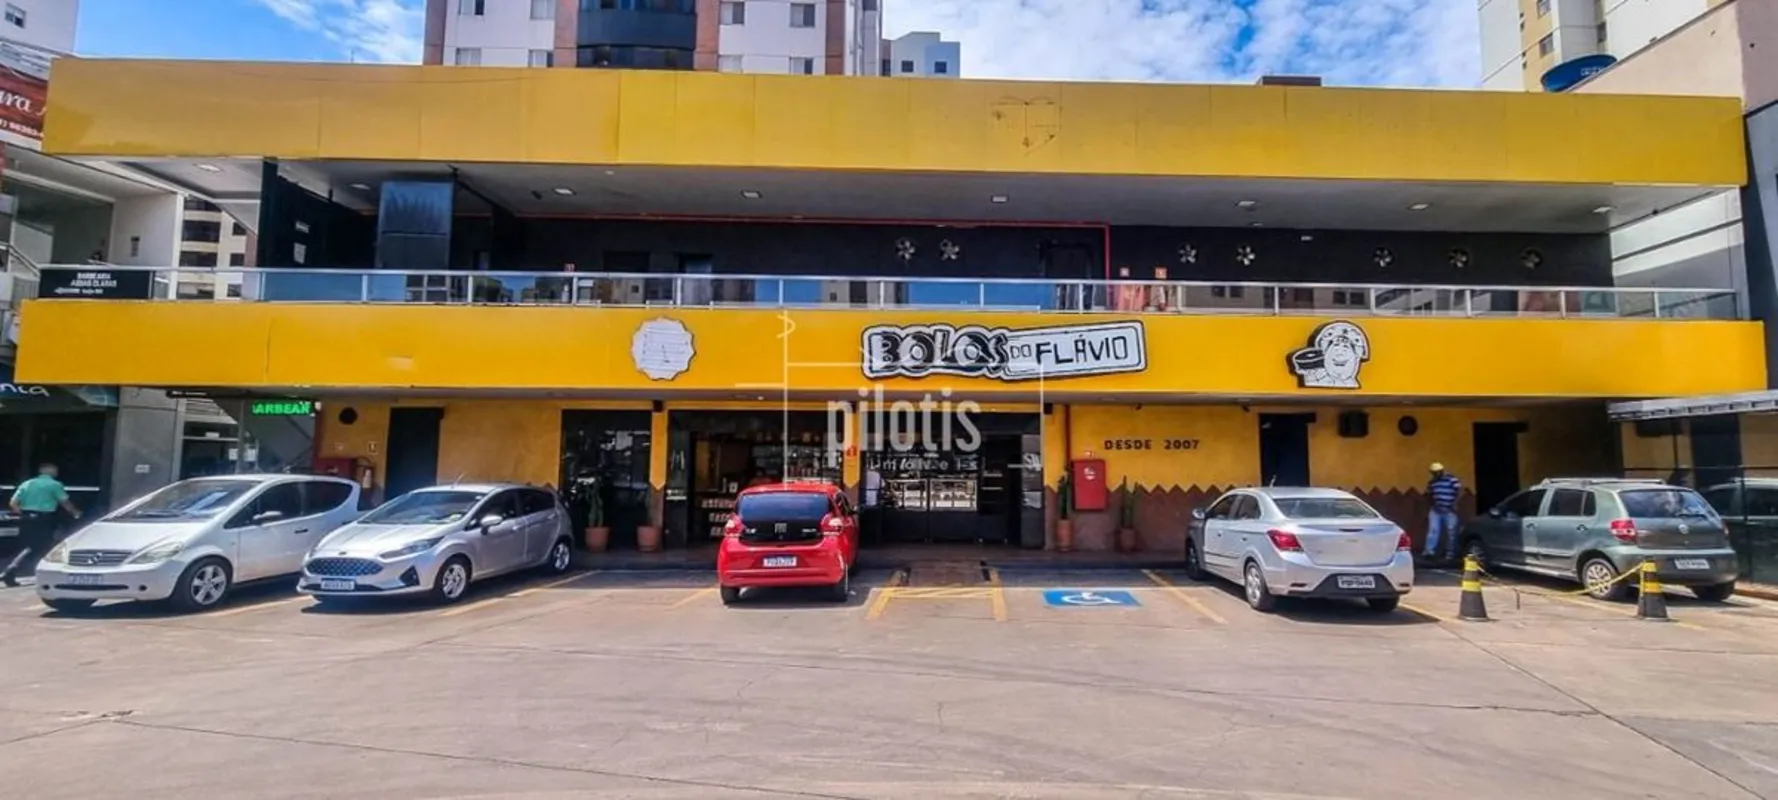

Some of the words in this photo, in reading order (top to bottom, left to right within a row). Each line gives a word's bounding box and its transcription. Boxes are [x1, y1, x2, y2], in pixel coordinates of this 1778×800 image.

[868, 329, 1008, 373] BOLOS
[1010, 343, 1032, 359] DO
[1035, 334, 1128, 364] FLÁVIO
[1104, 439, 1152, 450] DESDE
[1164, 439, 1199, 450] 2007
